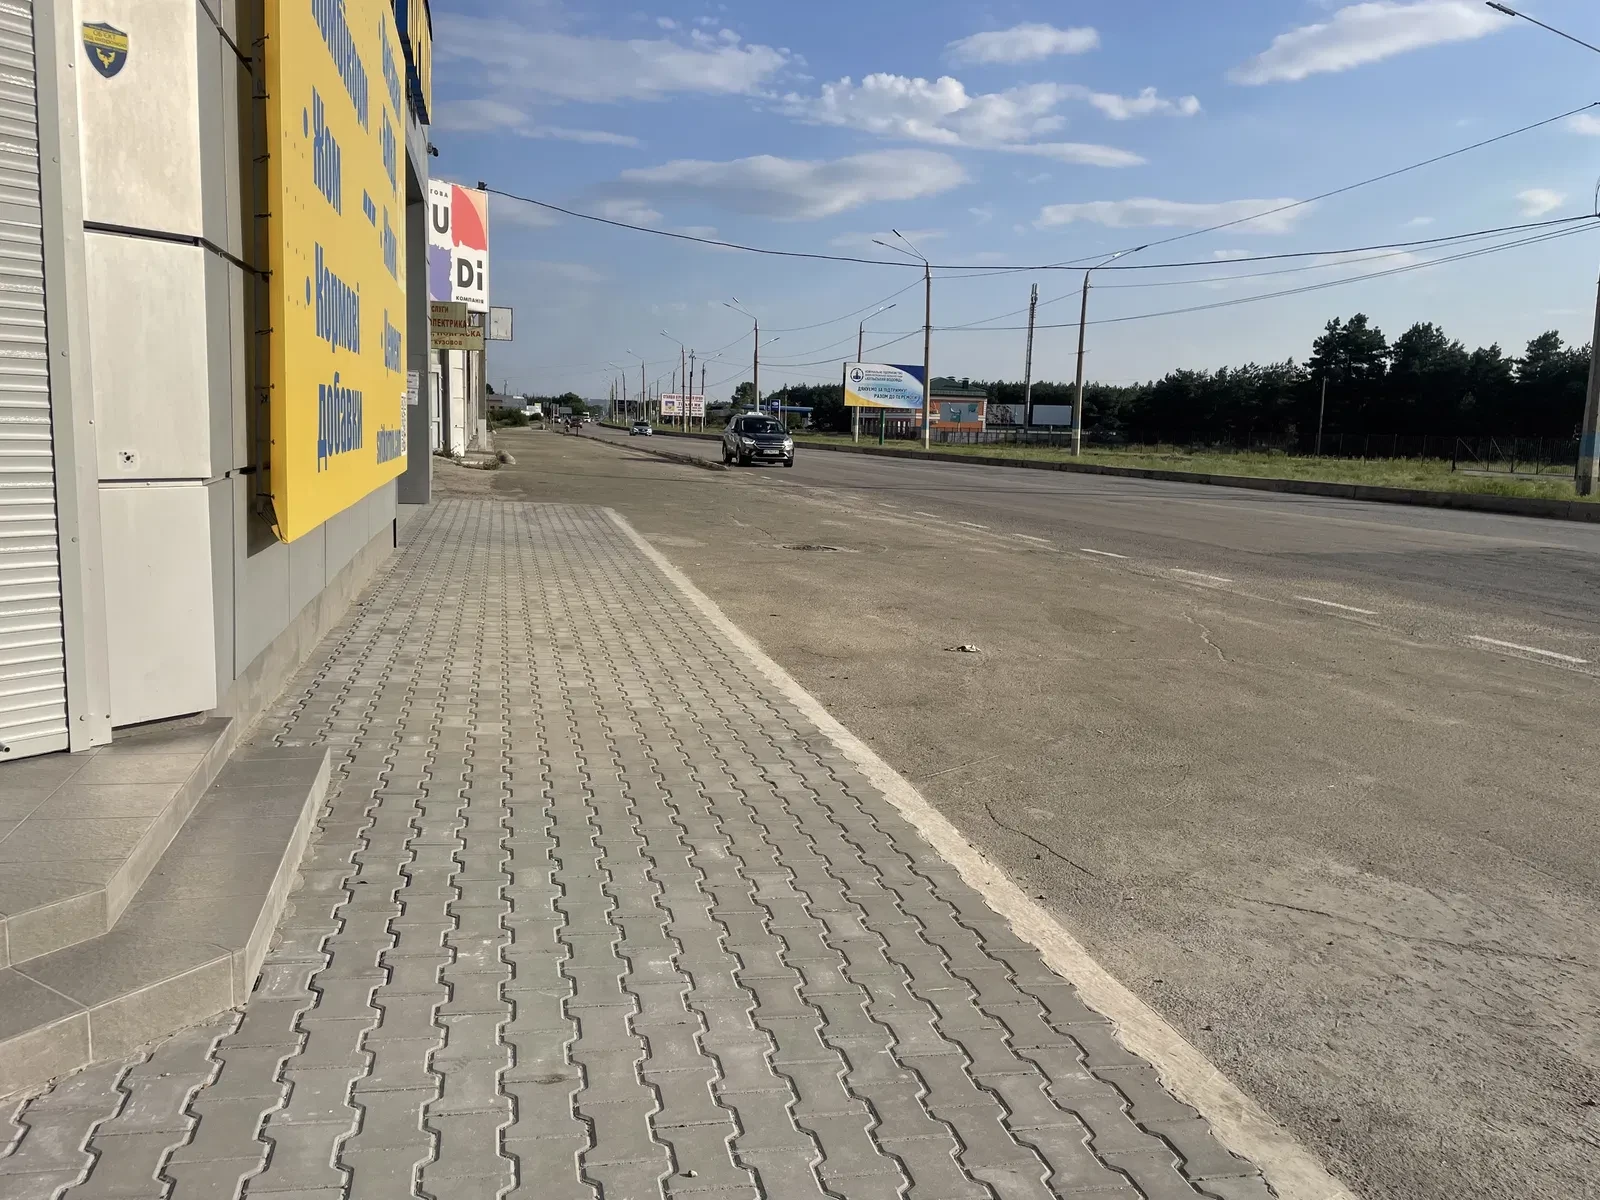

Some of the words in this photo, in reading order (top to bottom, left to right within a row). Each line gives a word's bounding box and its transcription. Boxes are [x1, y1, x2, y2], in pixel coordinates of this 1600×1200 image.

[312, 0, 368, 135] омбікорм
[312, 84, 341, 217] Жом
[315, 241, 360, 355] Кормові
[456, 295, 484, 304] КОМПАНІЯ
[457, 258, 483, 291] Di
[431, 318, 467, 329] ЛЕКТРИКА
